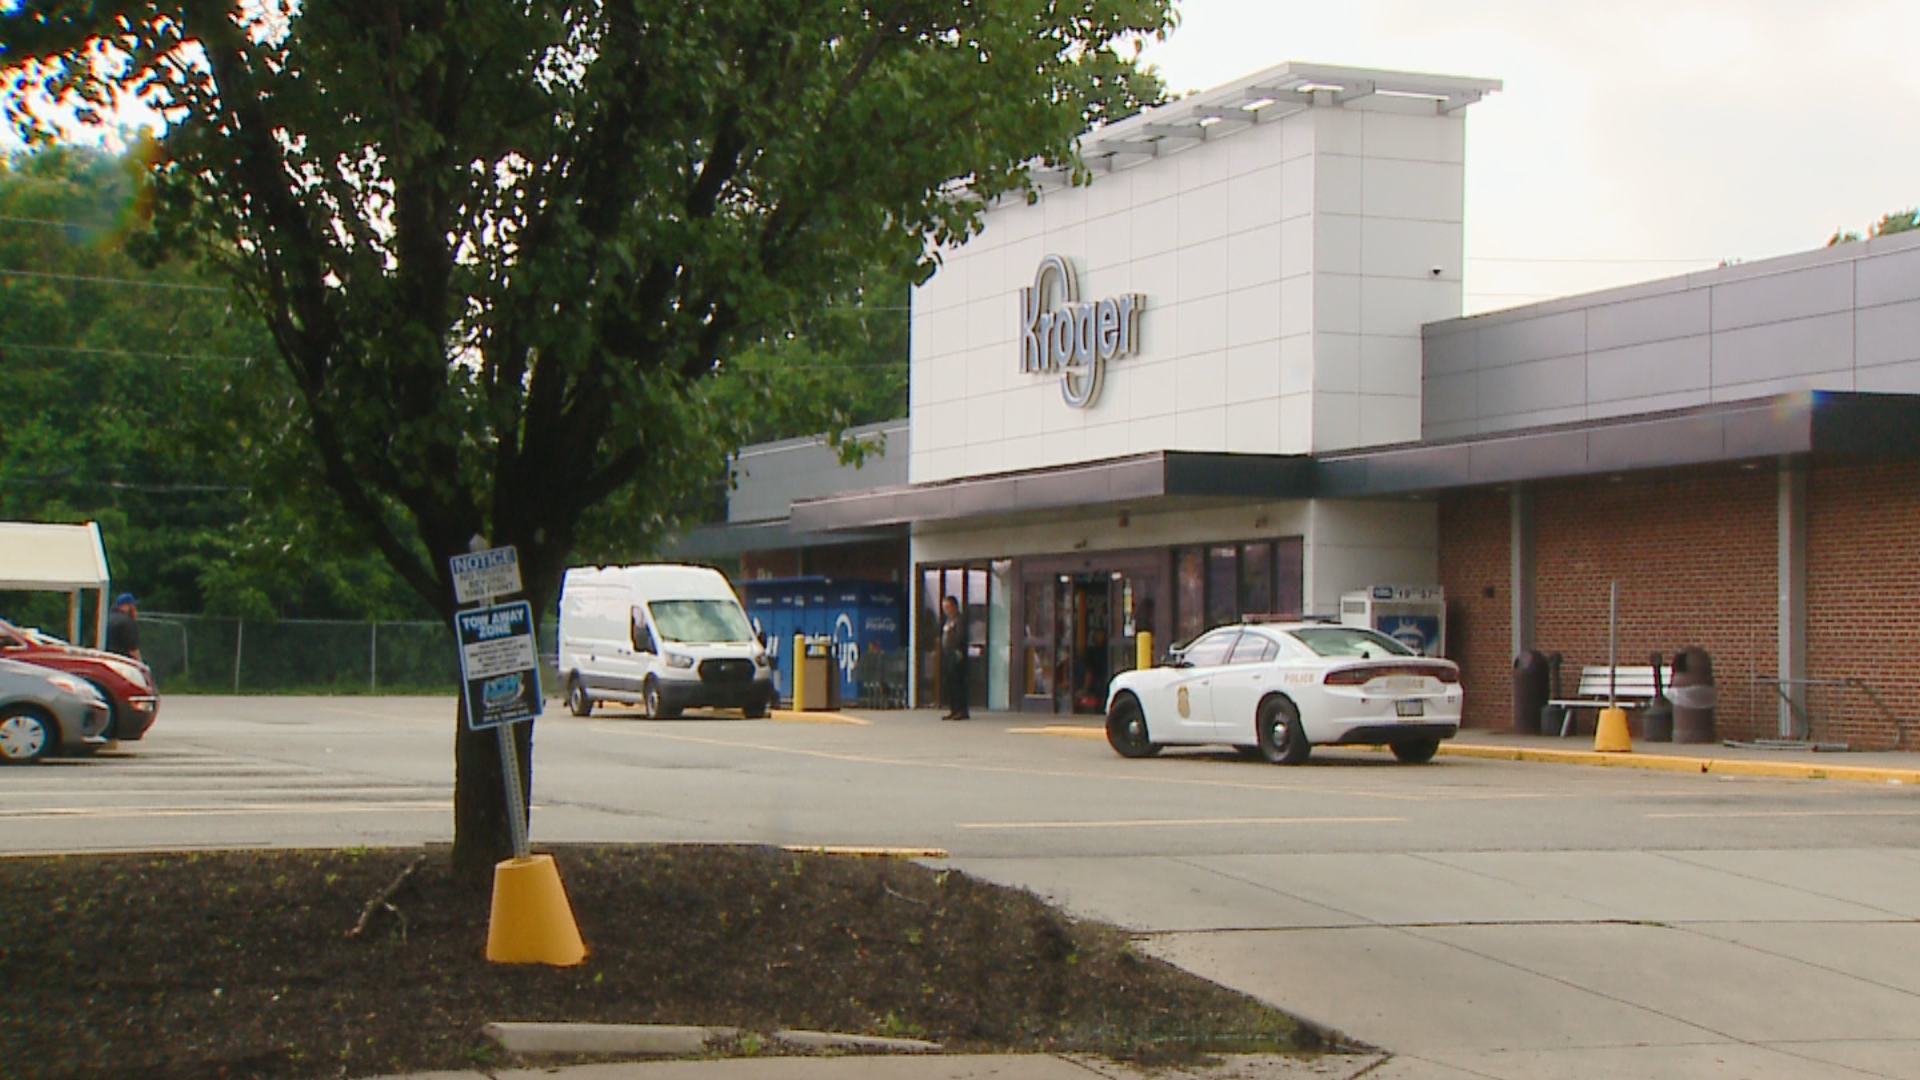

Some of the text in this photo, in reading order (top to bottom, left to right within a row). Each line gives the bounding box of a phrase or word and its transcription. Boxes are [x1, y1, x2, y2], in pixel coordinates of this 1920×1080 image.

[1019, 253, 1146, 410] Kroger
[454, 548, 515, 574] NOTICE
[461, 608, 524, 631] TOW AWAY
[478, 623, 513, 640] ZONE
[1284, 673, 1315, 684] POLICE
